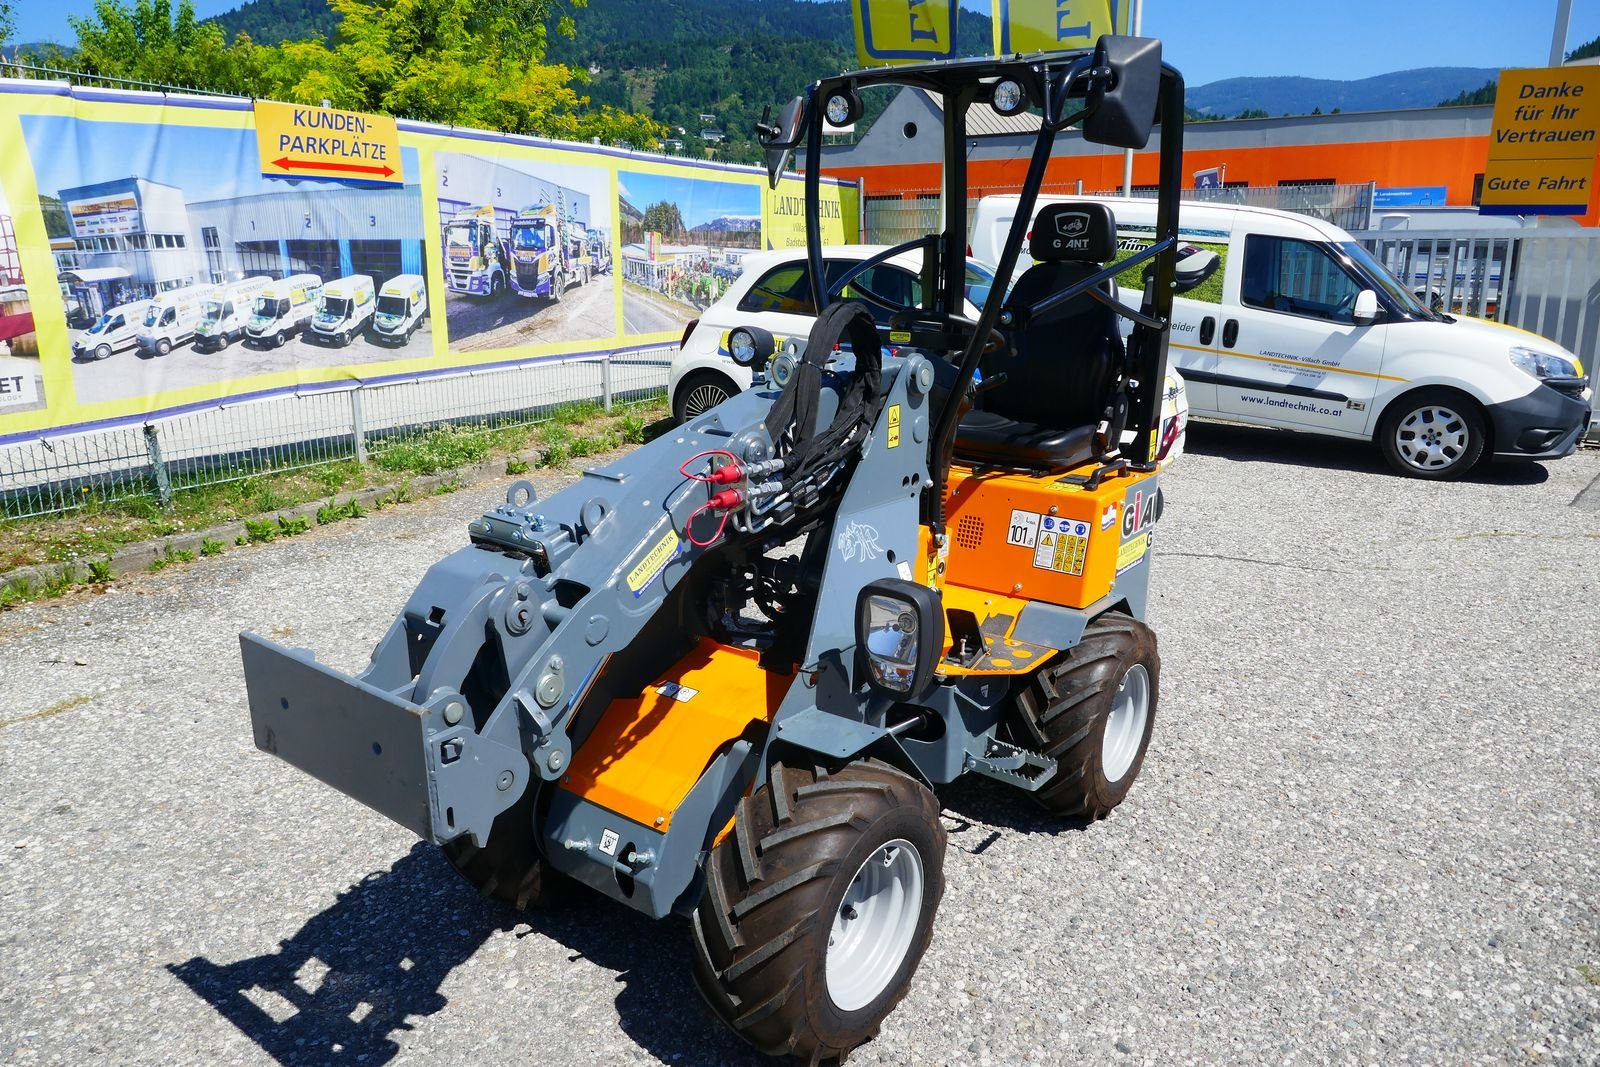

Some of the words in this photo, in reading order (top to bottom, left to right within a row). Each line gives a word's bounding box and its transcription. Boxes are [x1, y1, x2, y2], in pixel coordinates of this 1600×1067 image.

[1518, 82, 1584, 99] Danke
[295, 109, 372, 133] KUNDEN-
[1514, 105, 1545, 121] für
[1551, 104, 1580, 120] Ihr
[1496, 129, 1596, 143] Vertrauen
[280, 135, 386, 160] PARKPLÄTZE
[1487, 177, 1531, 191] Gute
[1537, 175, 1587, 190] Fahrt
[305, 218, 311, 228] 2
[370, 216, 376, 227] 3
[1241, 395, 1342, 416] www.landtechnik.co.at
[1011, 525, 1028, 544] 101
[629, 534, 674, 583] LANDTECHNIK
